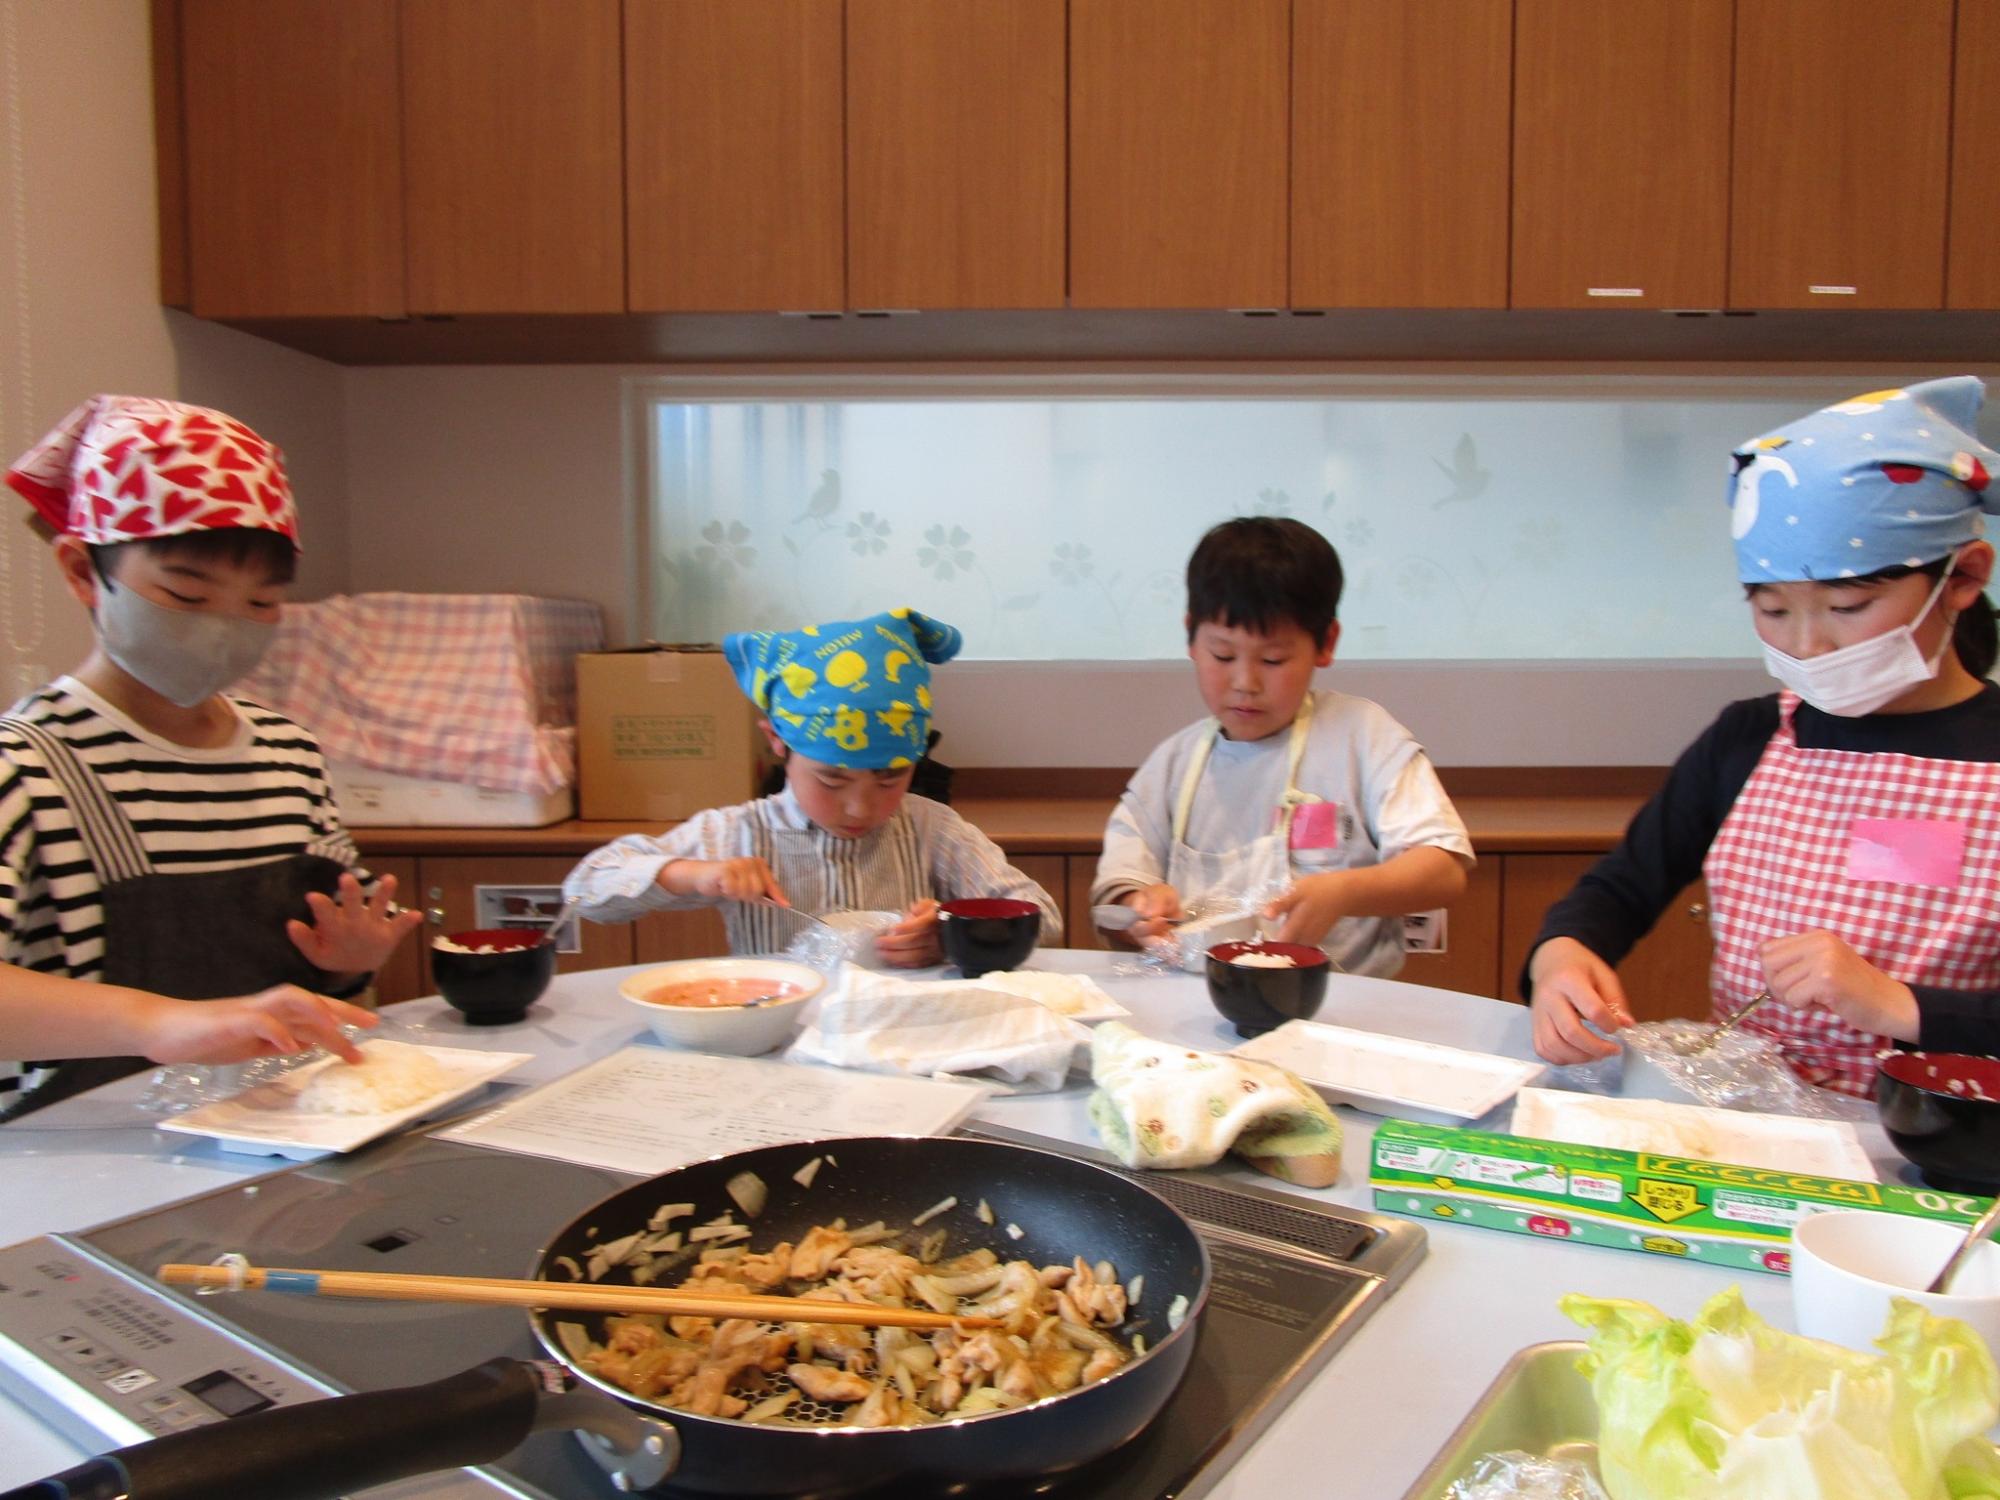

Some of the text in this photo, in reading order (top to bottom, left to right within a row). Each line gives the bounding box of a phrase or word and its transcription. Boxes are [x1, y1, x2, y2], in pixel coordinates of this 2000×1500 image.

[1649, 1158, 1866, 1199] サランラップ
